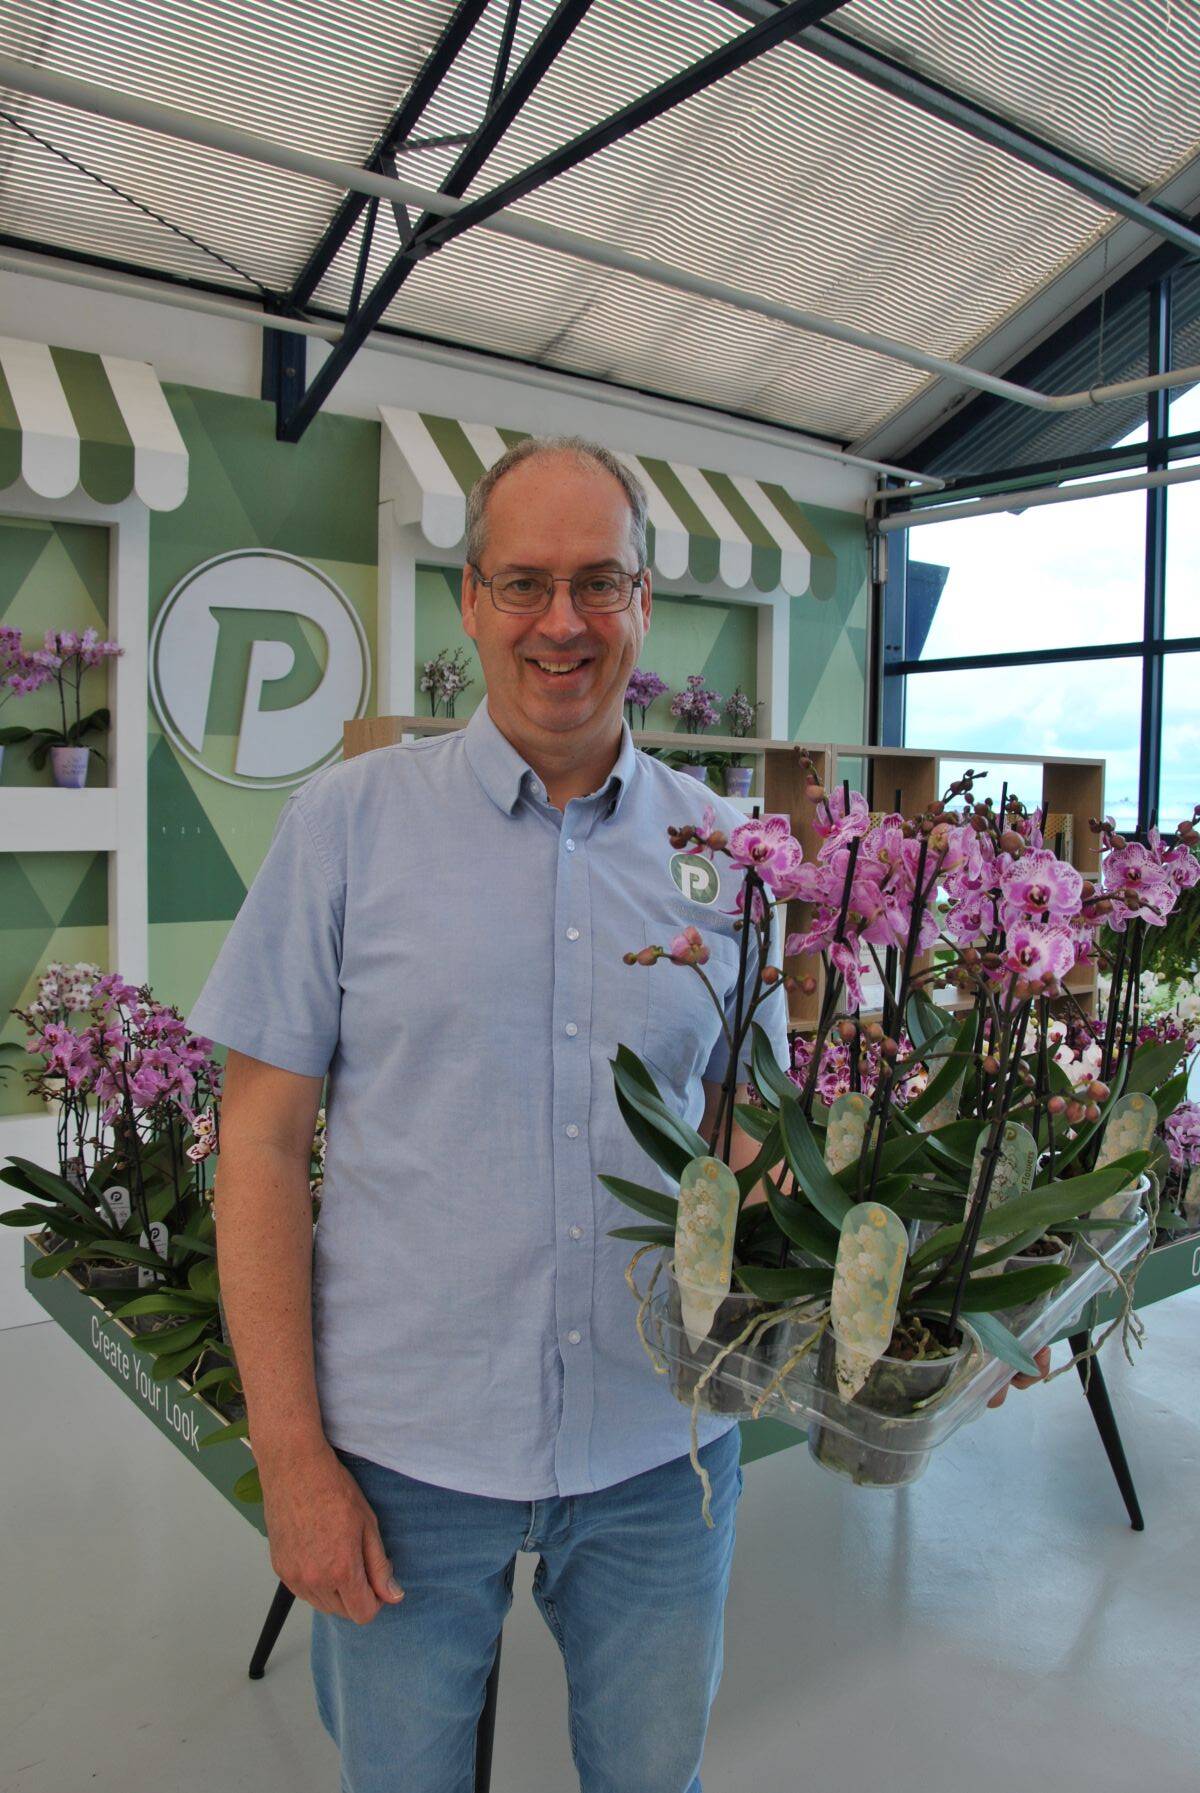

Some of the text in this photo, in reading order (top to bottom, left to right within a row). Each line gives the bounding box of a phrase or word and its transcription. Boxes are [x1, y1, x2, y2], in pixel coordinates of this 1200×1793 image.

[200, 605, 331, 779] P
[678, 861, 711, 900] P
[91, 1315, 200, 1452] Create Your Look
